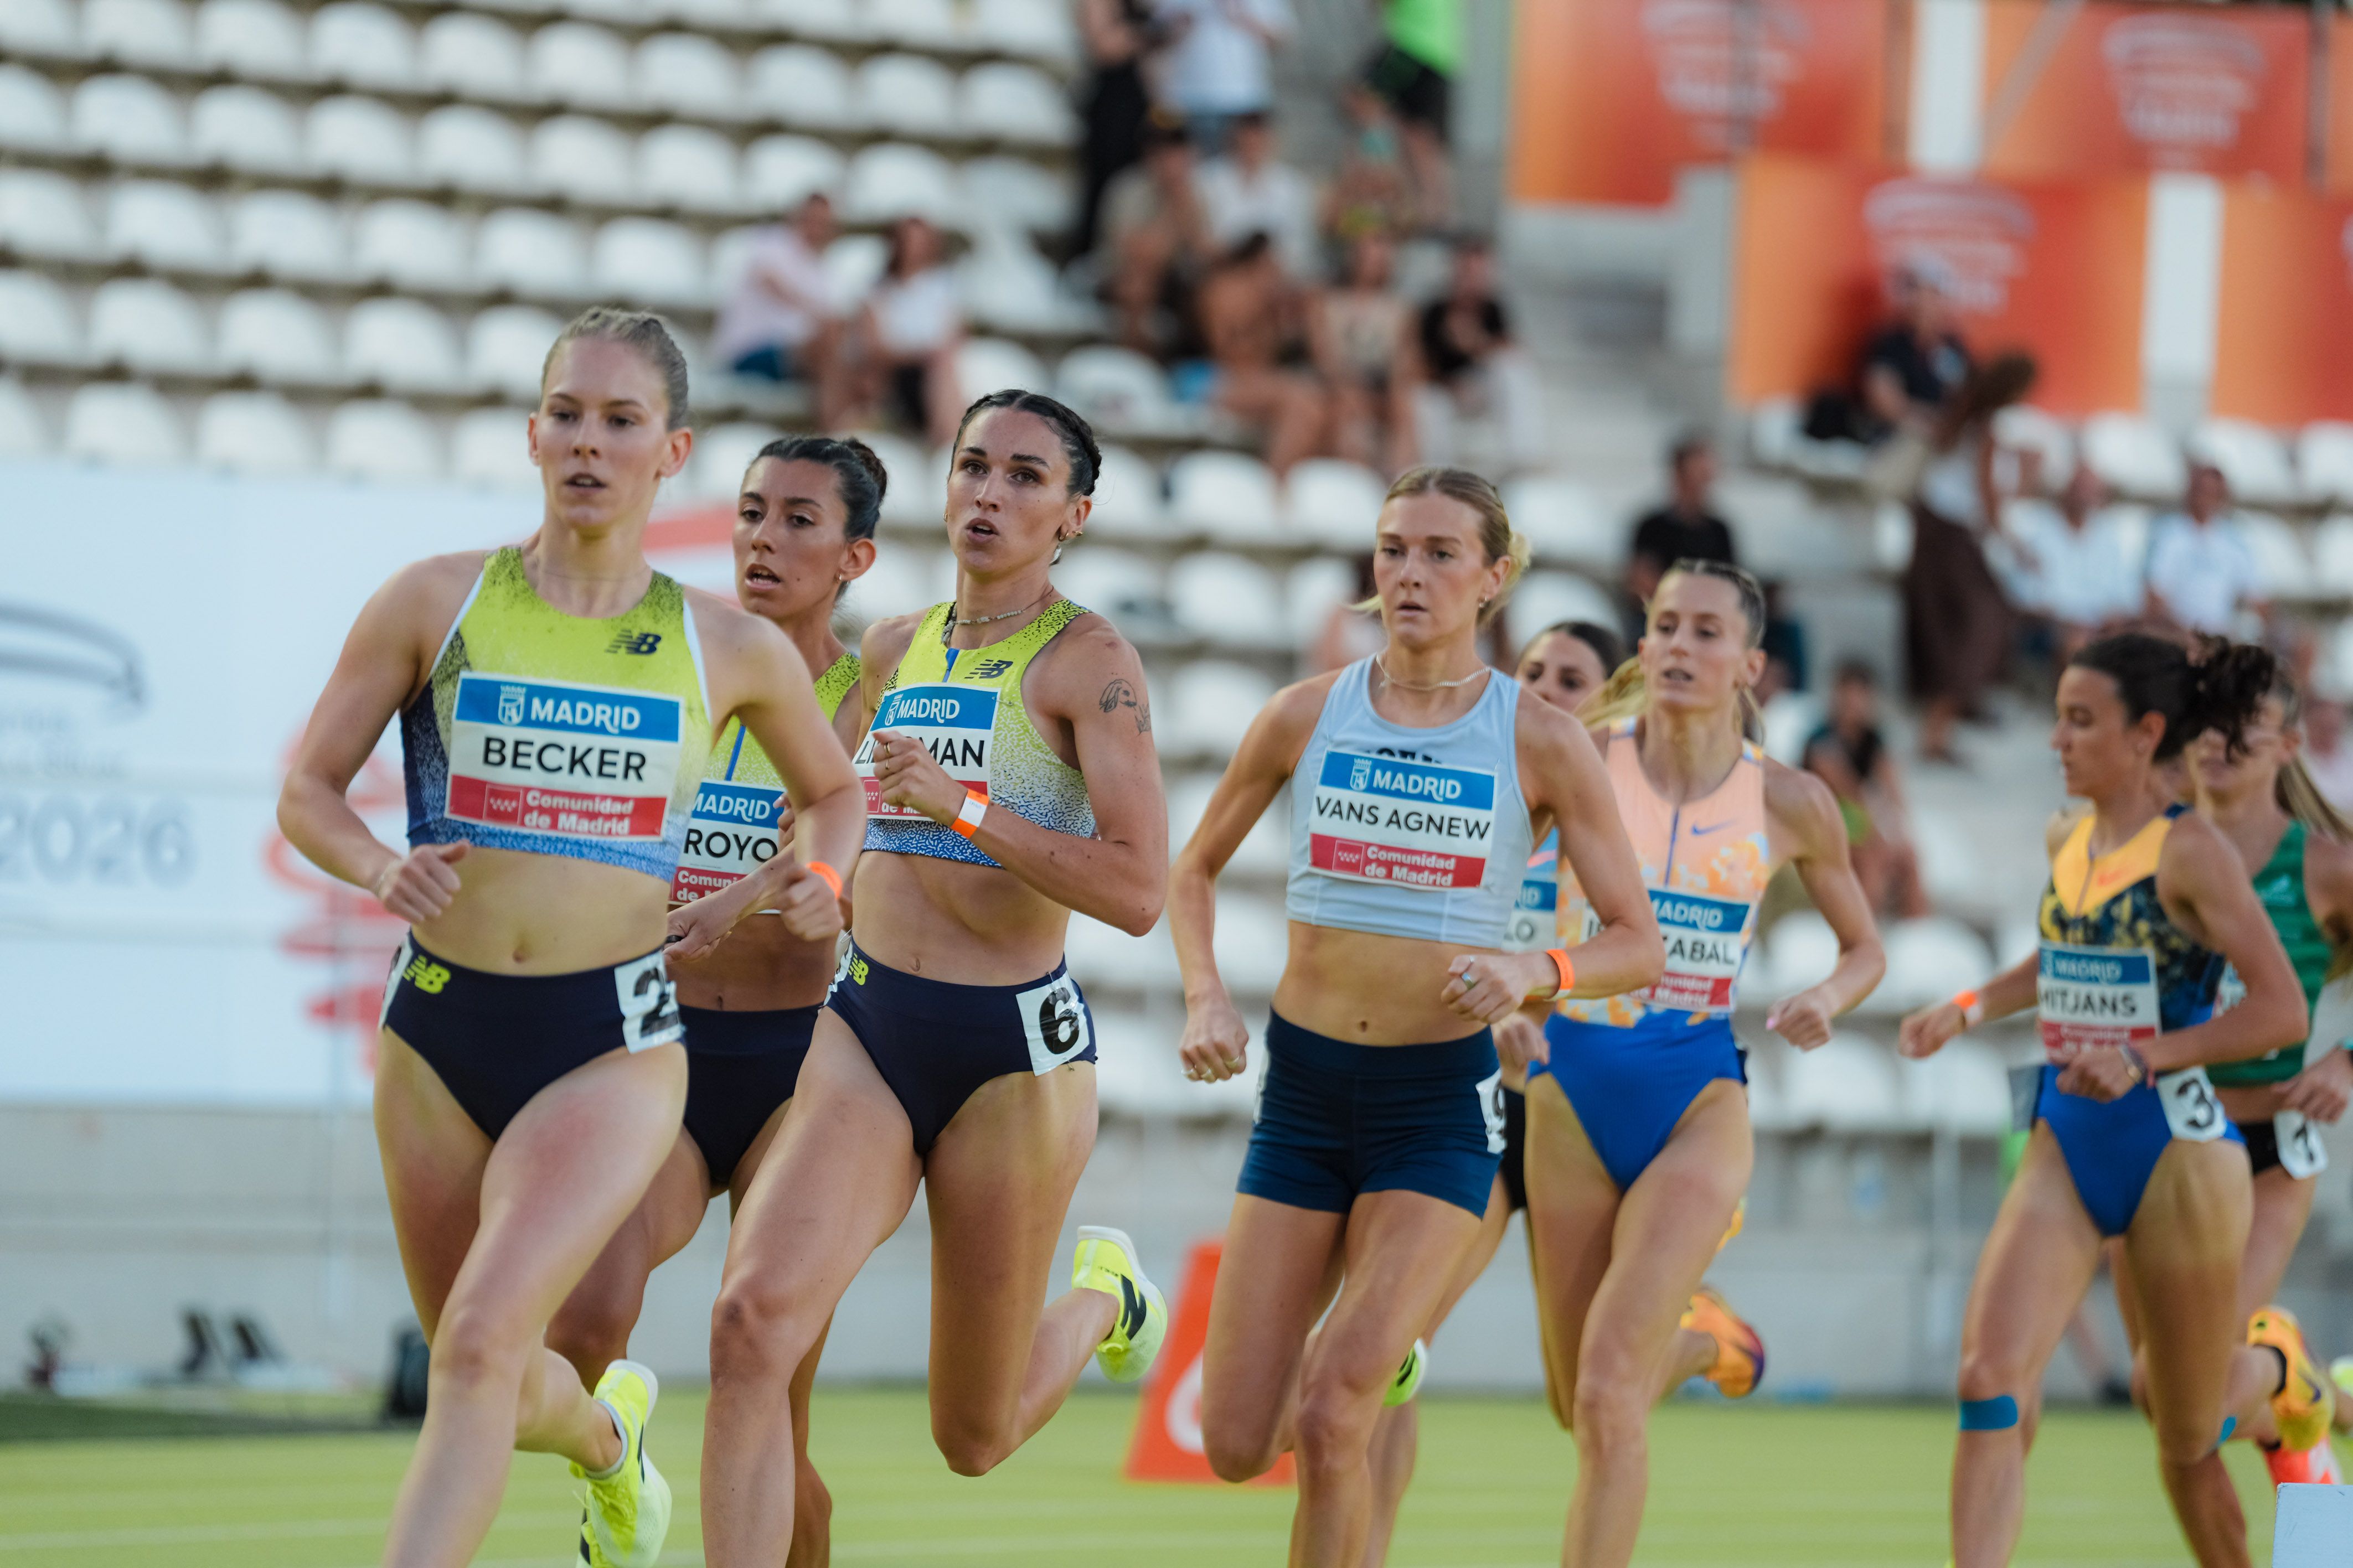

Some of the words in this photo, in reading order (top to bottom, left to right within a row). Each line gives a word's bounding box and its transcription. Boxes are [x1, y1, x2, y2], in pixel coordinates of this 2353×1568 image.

[530, 696, 641, 734] MADRID
[897, 698, 960, 723] MADRID
[483, 736, 647, 783] BECKER
[855, 737, 985, 768] LIMAN
[1372, 769, 1462, 802] MADRID
[527, 790, 634, 814] Comunidad
[1315, 795, 1379, 825] VANS
[1385, 809, 1490, 841] AGNEW
[524, 810, 551, 829] de
[557, 813, 630, 835] Madrid
[1366, 846, 1456, 870] Comunidad
[1364, 863, 1386, 878] de
[1392, 865, 1453, 886] Madrid
[677, 888, 698, 902] de
[634, 967, 679, 1037] 2
[1039, 987, 1080, 1054] 6
[2176, 1078, 2214, 1129] 3
